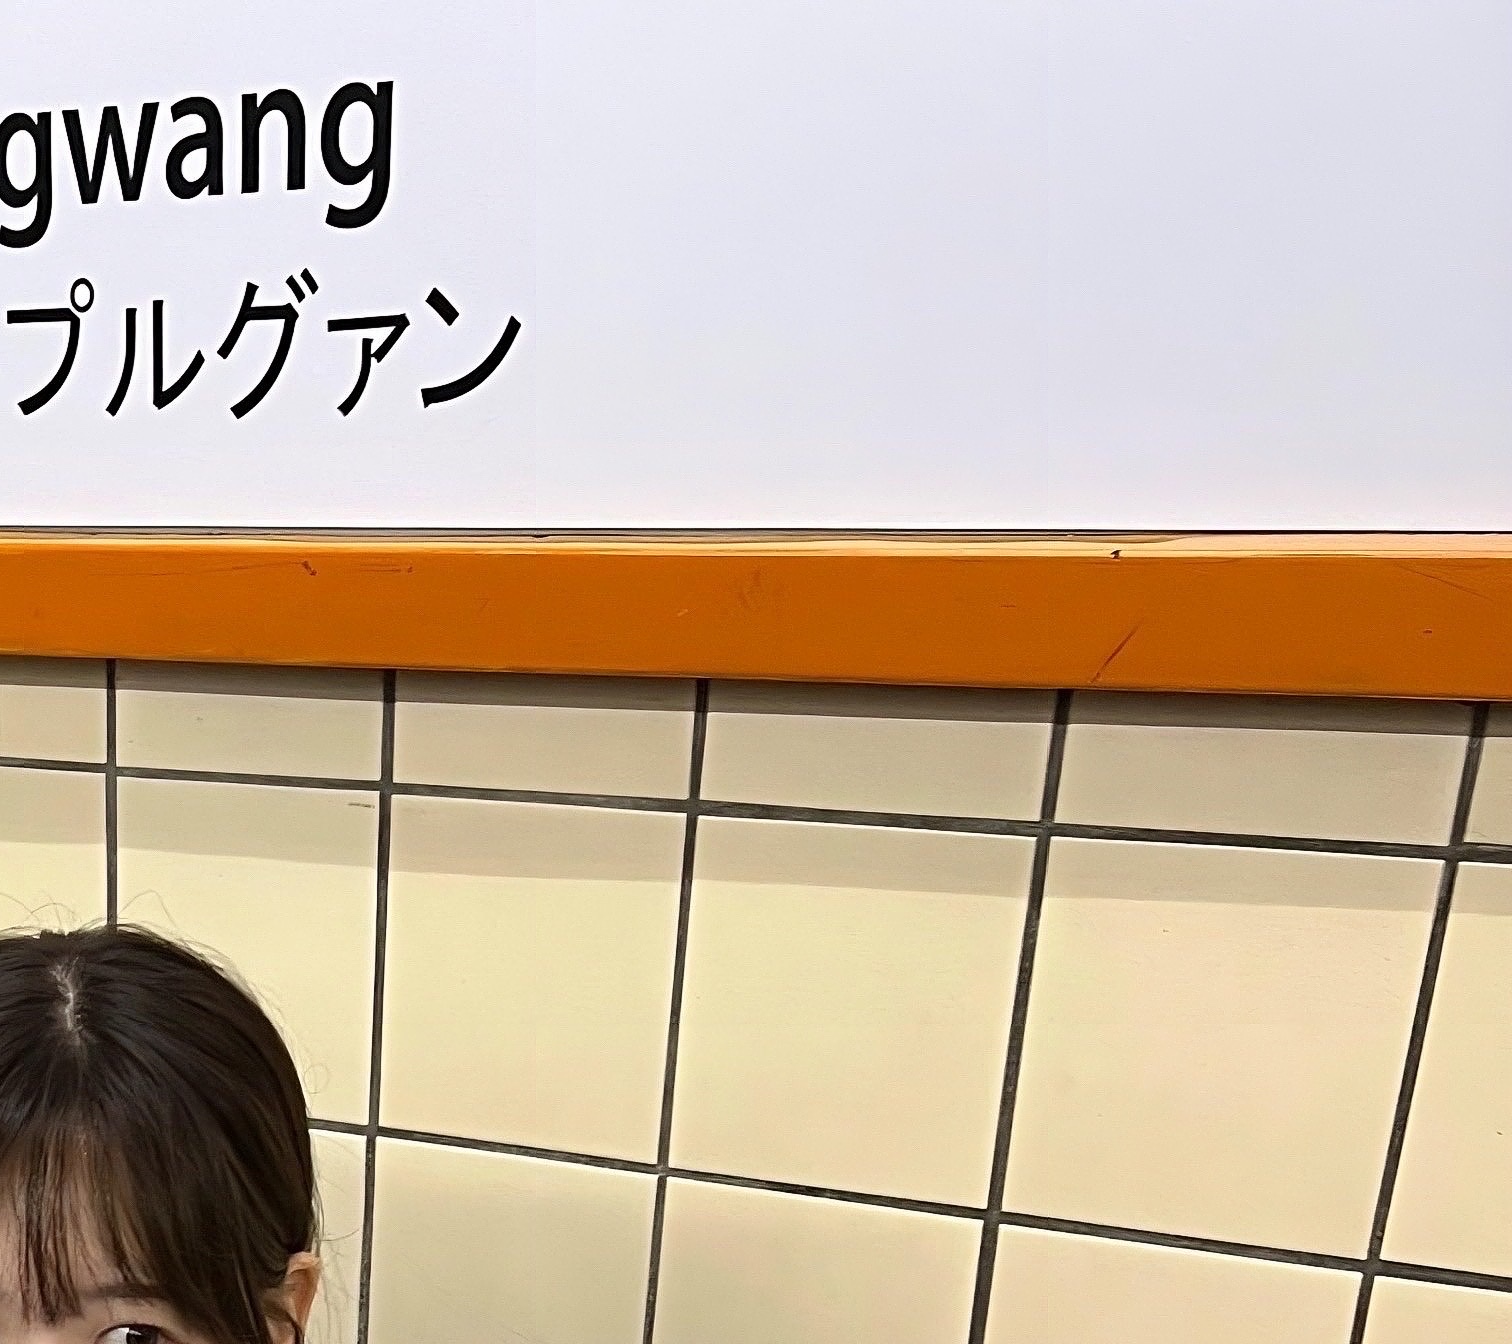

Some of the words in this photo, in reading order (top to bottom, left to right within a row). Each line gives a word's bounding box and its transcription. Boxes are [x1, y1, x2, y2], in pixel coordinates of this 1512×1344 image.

[6, 267, 522, 420] プルグァン
